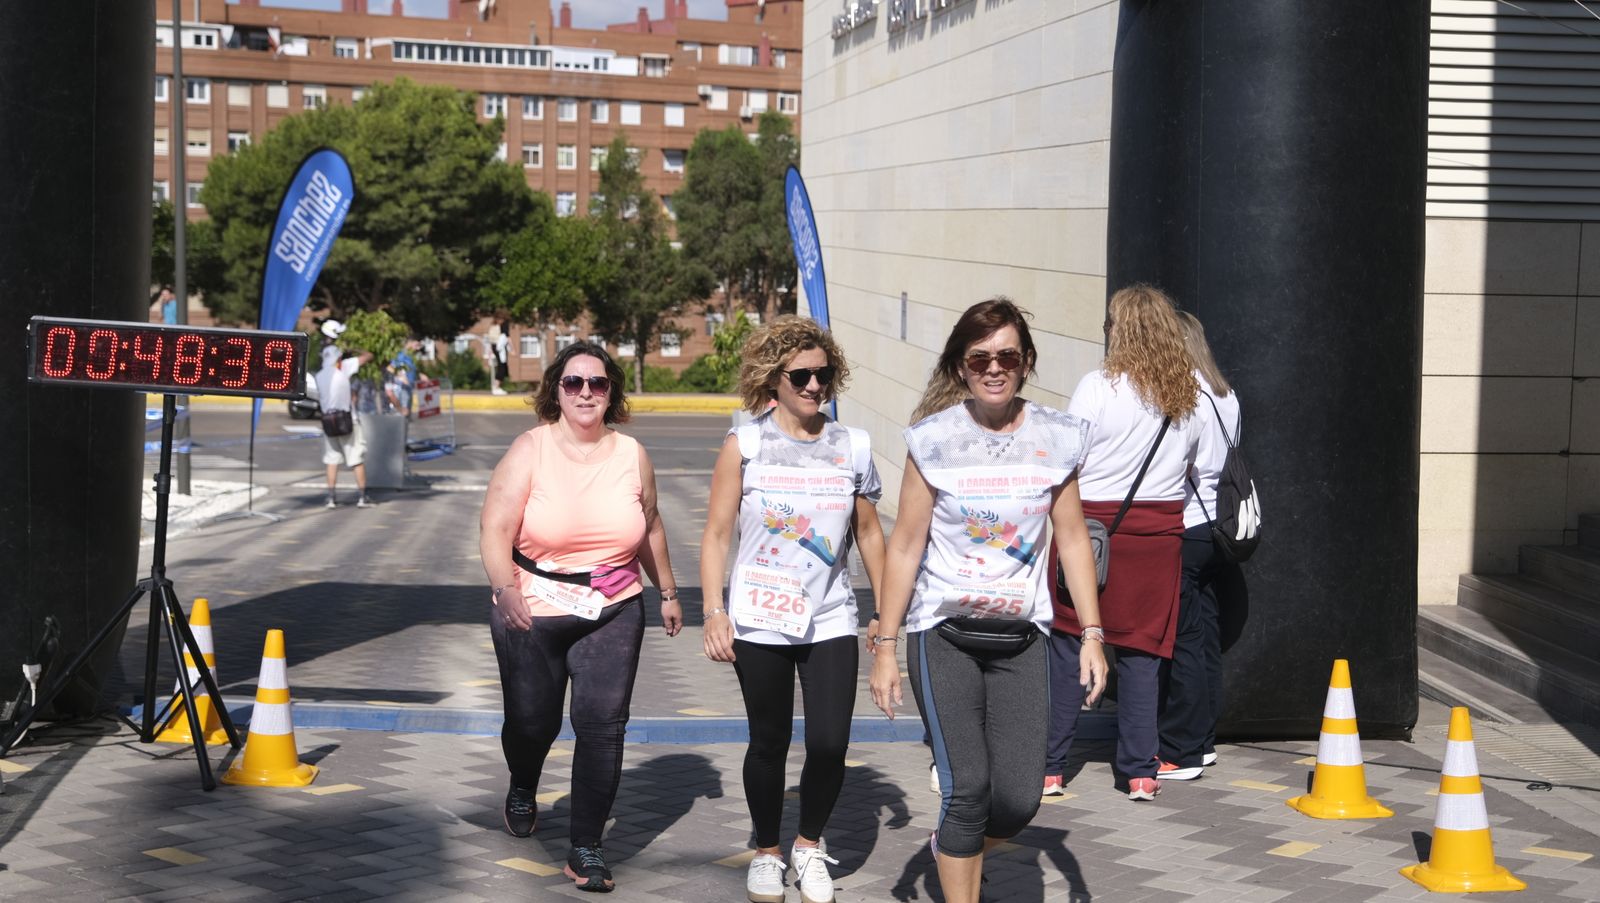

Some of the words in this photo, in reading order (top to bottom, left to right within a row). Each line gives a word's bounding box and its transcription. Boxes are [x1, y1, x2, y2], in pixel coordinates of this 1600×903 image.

[44, 327, 293, 390] 00:48:39
[768, 476, 806, 486] CARRERA
[808, 476, 822, 486] SIN
[967, 477, 1010, 488] CARRERA
[1012, 476, 1029, 487] SIN
[748, 588, 807, 616] 1226
[958, 593, 1024, 617] 1225
